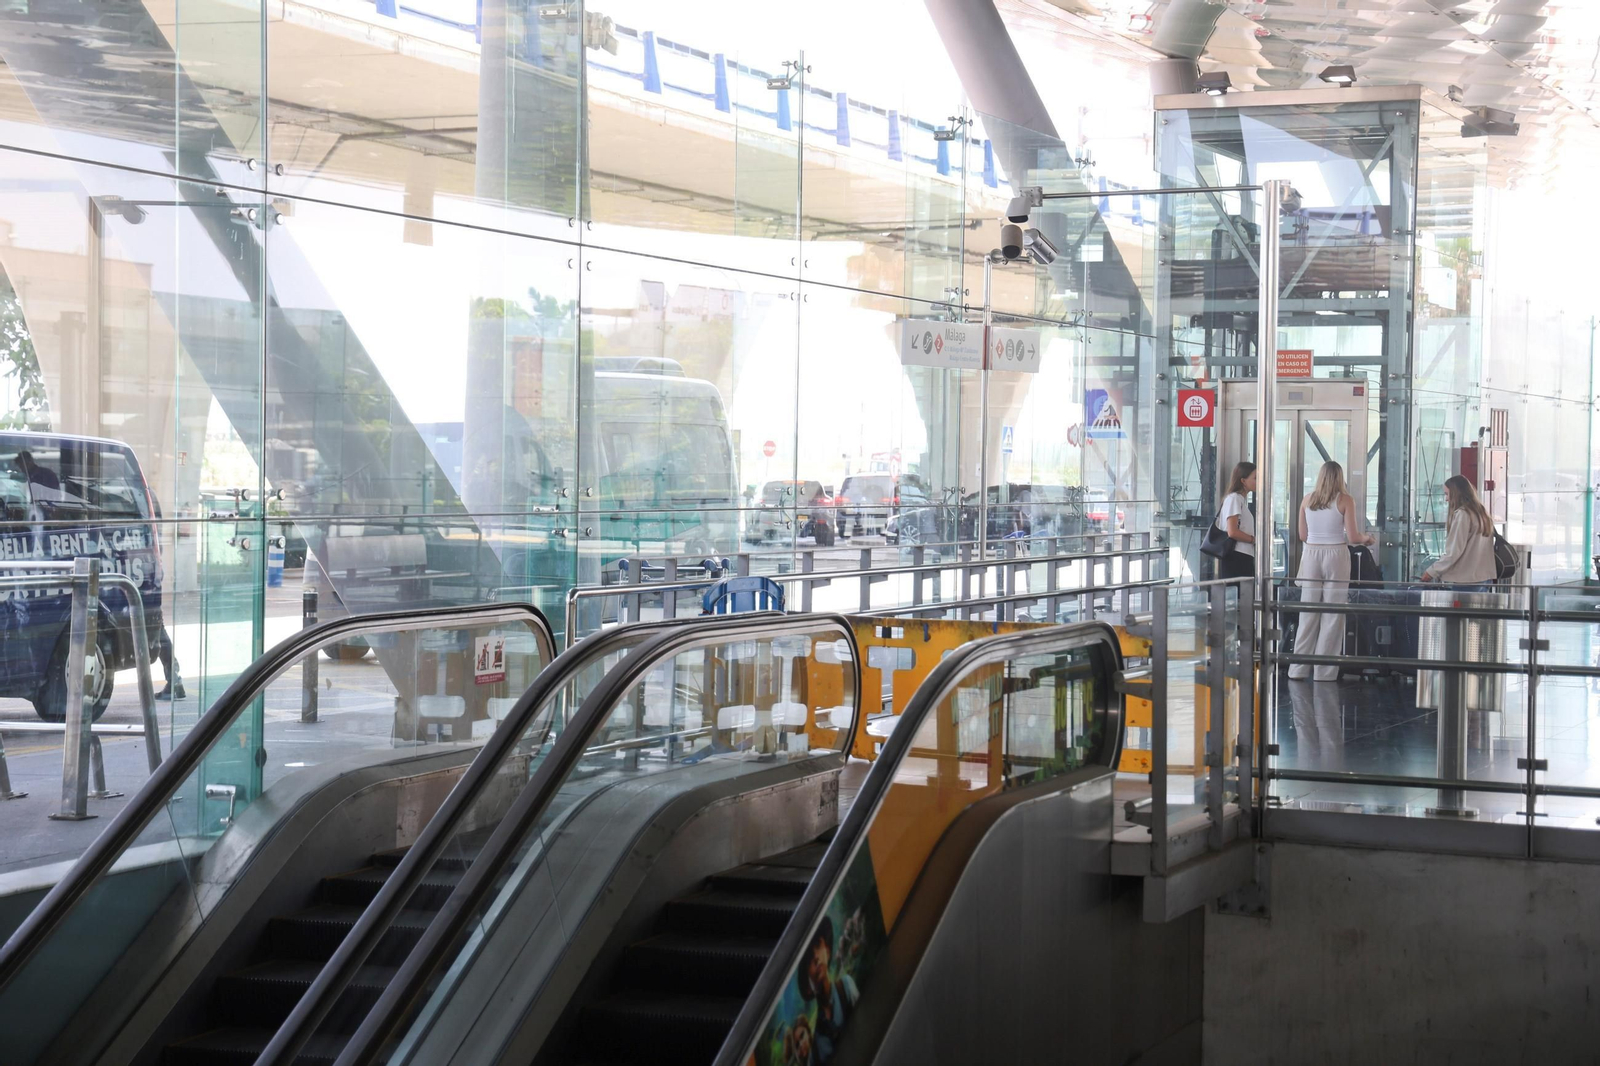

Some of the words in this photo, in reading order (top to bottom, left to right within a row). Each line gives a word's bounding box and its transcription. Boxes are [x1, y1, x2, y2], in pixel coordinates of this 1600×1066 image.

[945, 328, 966, 345] Málaga
[50, 533, 89, 556] RENT
[97, 533, 107, 552] A
[112, 530, 142, 551] CAR
